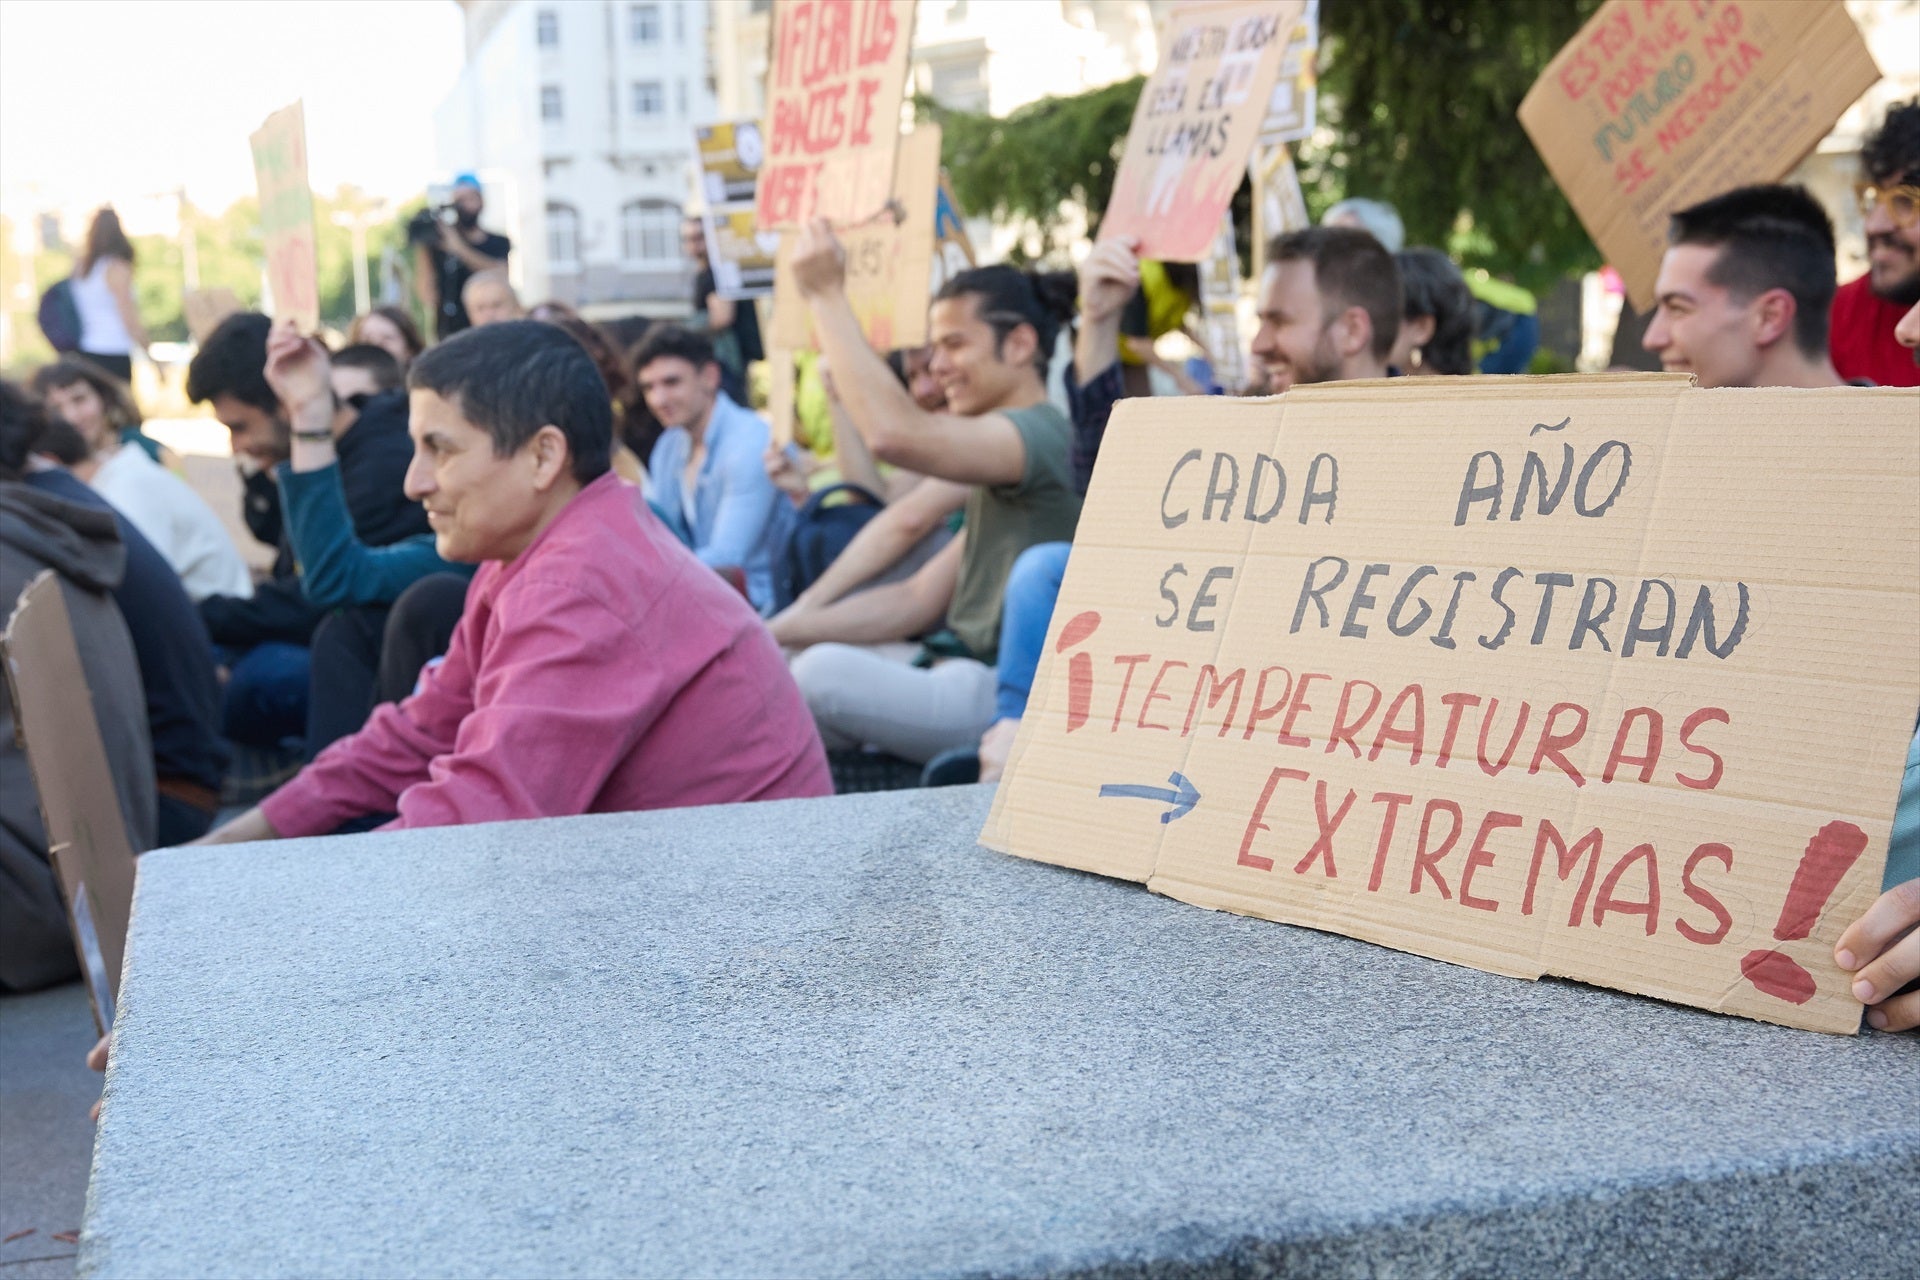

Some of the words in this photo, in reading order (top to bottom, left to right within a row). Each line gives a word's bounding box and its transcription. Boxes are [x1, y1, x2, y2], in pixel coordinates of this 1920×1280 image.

[1558, 8, 1634, 101] ESTOY
[1593, 52, 1696, 163] FUTURO
[1702, 3, 1744, 61] NO
[1655, 42, 1765, 155] NEGOCIA
[1146, 114, 1232, 158] LLAMAS
[1160, 447, 1340, 529] CADA
[1454, 416, 1633, 527] AÑO
[1156, 562, 1235, 632] SE
[1288, 555, 1751, 661] REGISTRAN
